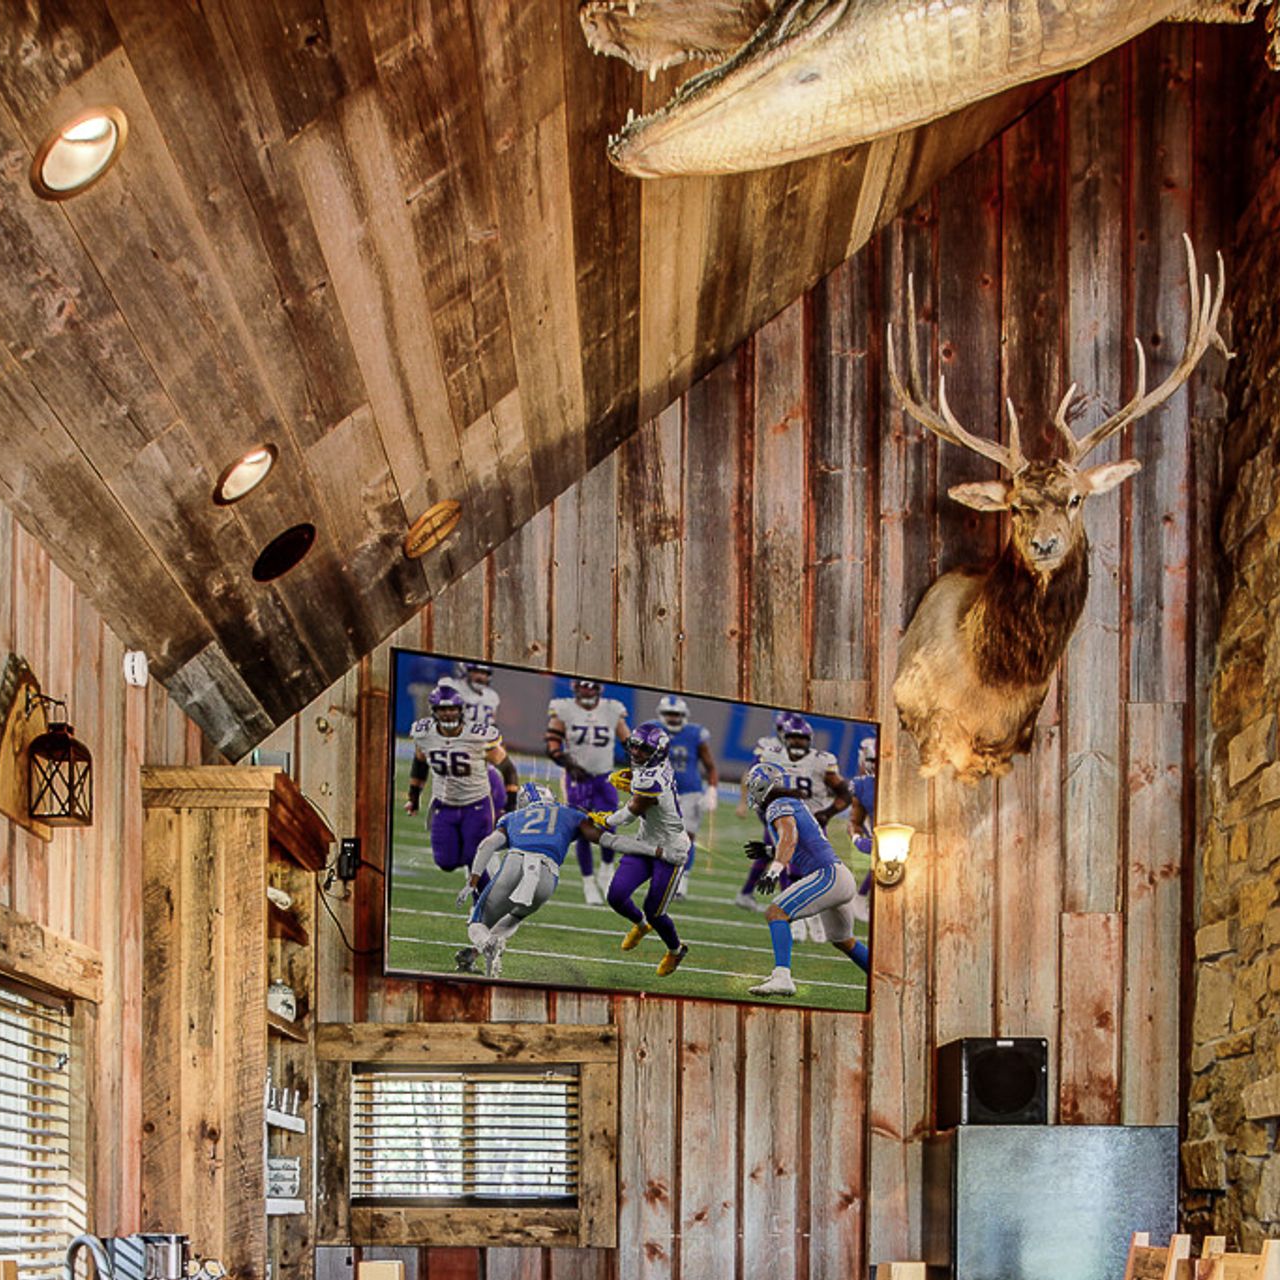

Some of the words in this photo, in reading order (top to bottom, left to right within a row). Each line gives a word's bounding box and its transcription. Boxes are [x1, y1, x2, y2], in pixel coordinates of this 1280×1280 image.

[572, 725, 610, 747] 75
[429, 750, 472, 777] 56
[520, 806, 560, 835] 21
